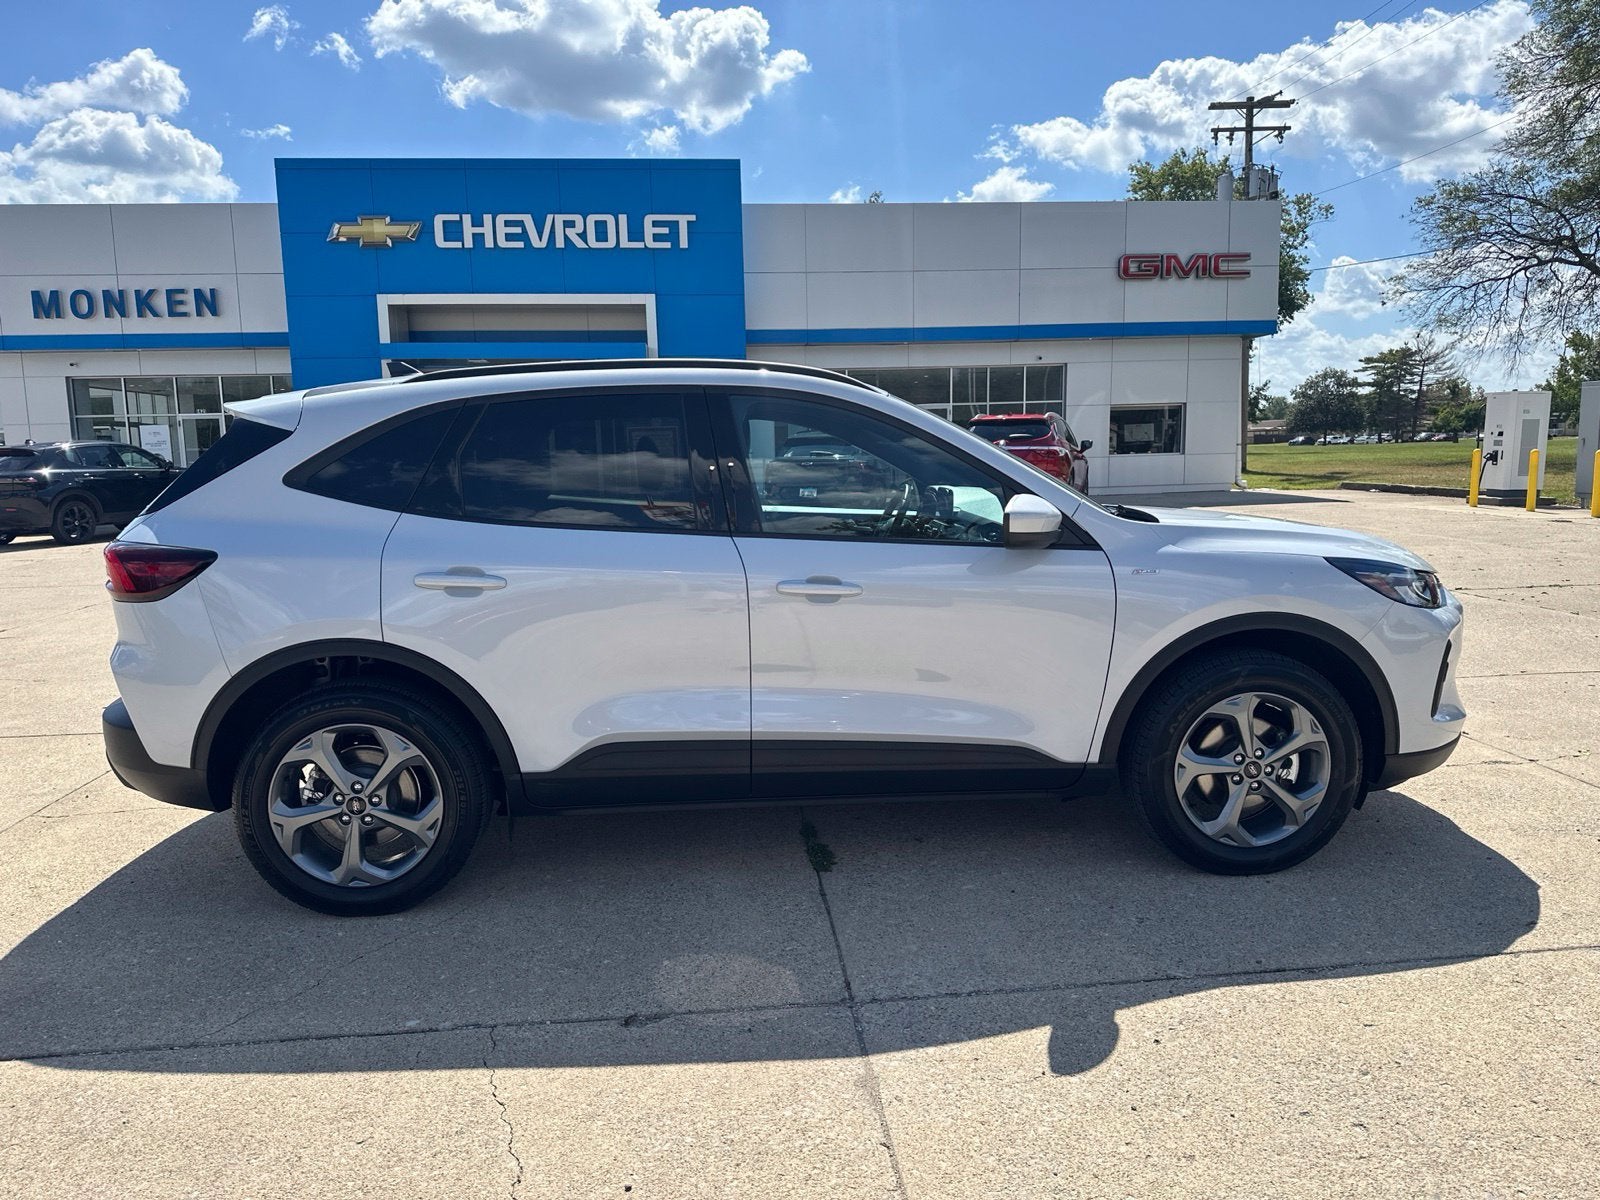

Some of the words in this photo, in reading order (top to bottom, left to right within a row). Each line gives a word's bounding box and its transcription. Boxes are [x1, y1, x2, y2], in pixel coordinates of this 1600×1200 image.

[434, 213, 697, 249] CHEVROLET
[1118, 252, 1252, 280] GMC
[31, 288, 220, 320] MONKEN
